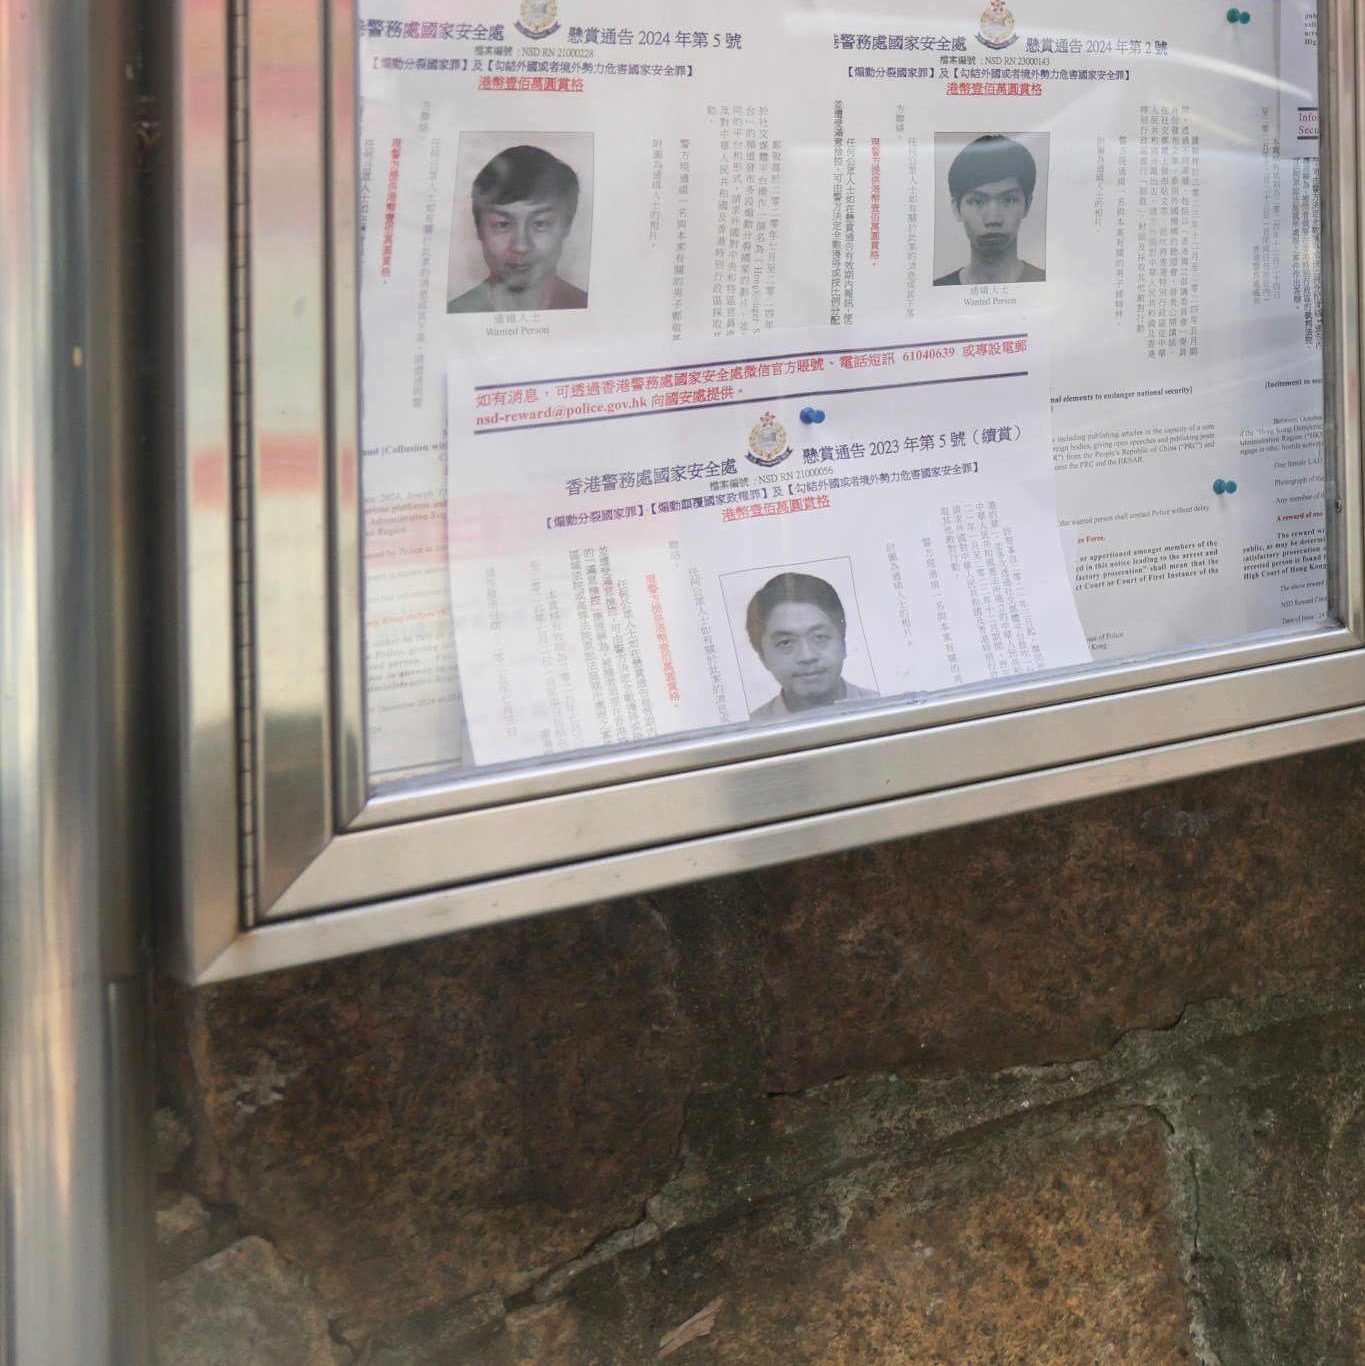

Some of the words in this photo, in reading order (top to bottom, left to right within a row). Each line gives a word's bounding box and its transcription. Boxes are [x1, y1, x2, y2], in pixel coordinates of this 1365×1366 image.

[568, 27, 634, 46] 懸賞通告
[639, 31, 670, 46] 2024
[676, 30, 708, 48] 年第
[714, 34, 720, 48] 5
[726, 34, 742, 50] 號
[1026, 37, 1082, 54] 懸賞通告
[1086, 41, 1113, 54] 2024
[1116, 40, 1141, 55] 年第
[1145, 42, 1151, 55] 2
[1155, 42, 1168, 56] 號
[542, 48, 554, 57] RN
[557, 48, 593, 58] 21000228
[940, 55, 976, 65] 檔案編號
[1004, 57, 1014, 65] RN
[1017, 58, 1050, 66] 23000143
[478, 76, 583, 91] 港幣壹佰萬圓賞格
[946, 82, 1042, 96] 港幣壹佰萬圓賞格
[486, 326, 517, 336] Wanted
[521, 325, 549, 334] Person
[903, 347, 955, 364] 61040639
[962, 338, 1027, 360] 或專設電郵
[1063, 393, 1093, 402] elements
[1104, 390, 1134, 401] endanger
[1137, 388, 1163, 397] national
[1165, 386, 1192, 397] security]
[476, 397, 647, 426] nsd-reward@police.gov.hk
[566, 458, 737, 497] 香港警務處國家安全處
[802, 442, 866, 466] 懸賞通告
[869, 438, 900, 457] 2023
[904, 434, 935, 453] 年第
[938, 433, 947, 449] 5
[950, 423, 1024, 448] 號（續賞）
[794, 466, 834, 480] 21000056
[722, 496, 831, 522] 港幣壹佰萬圓賞格
